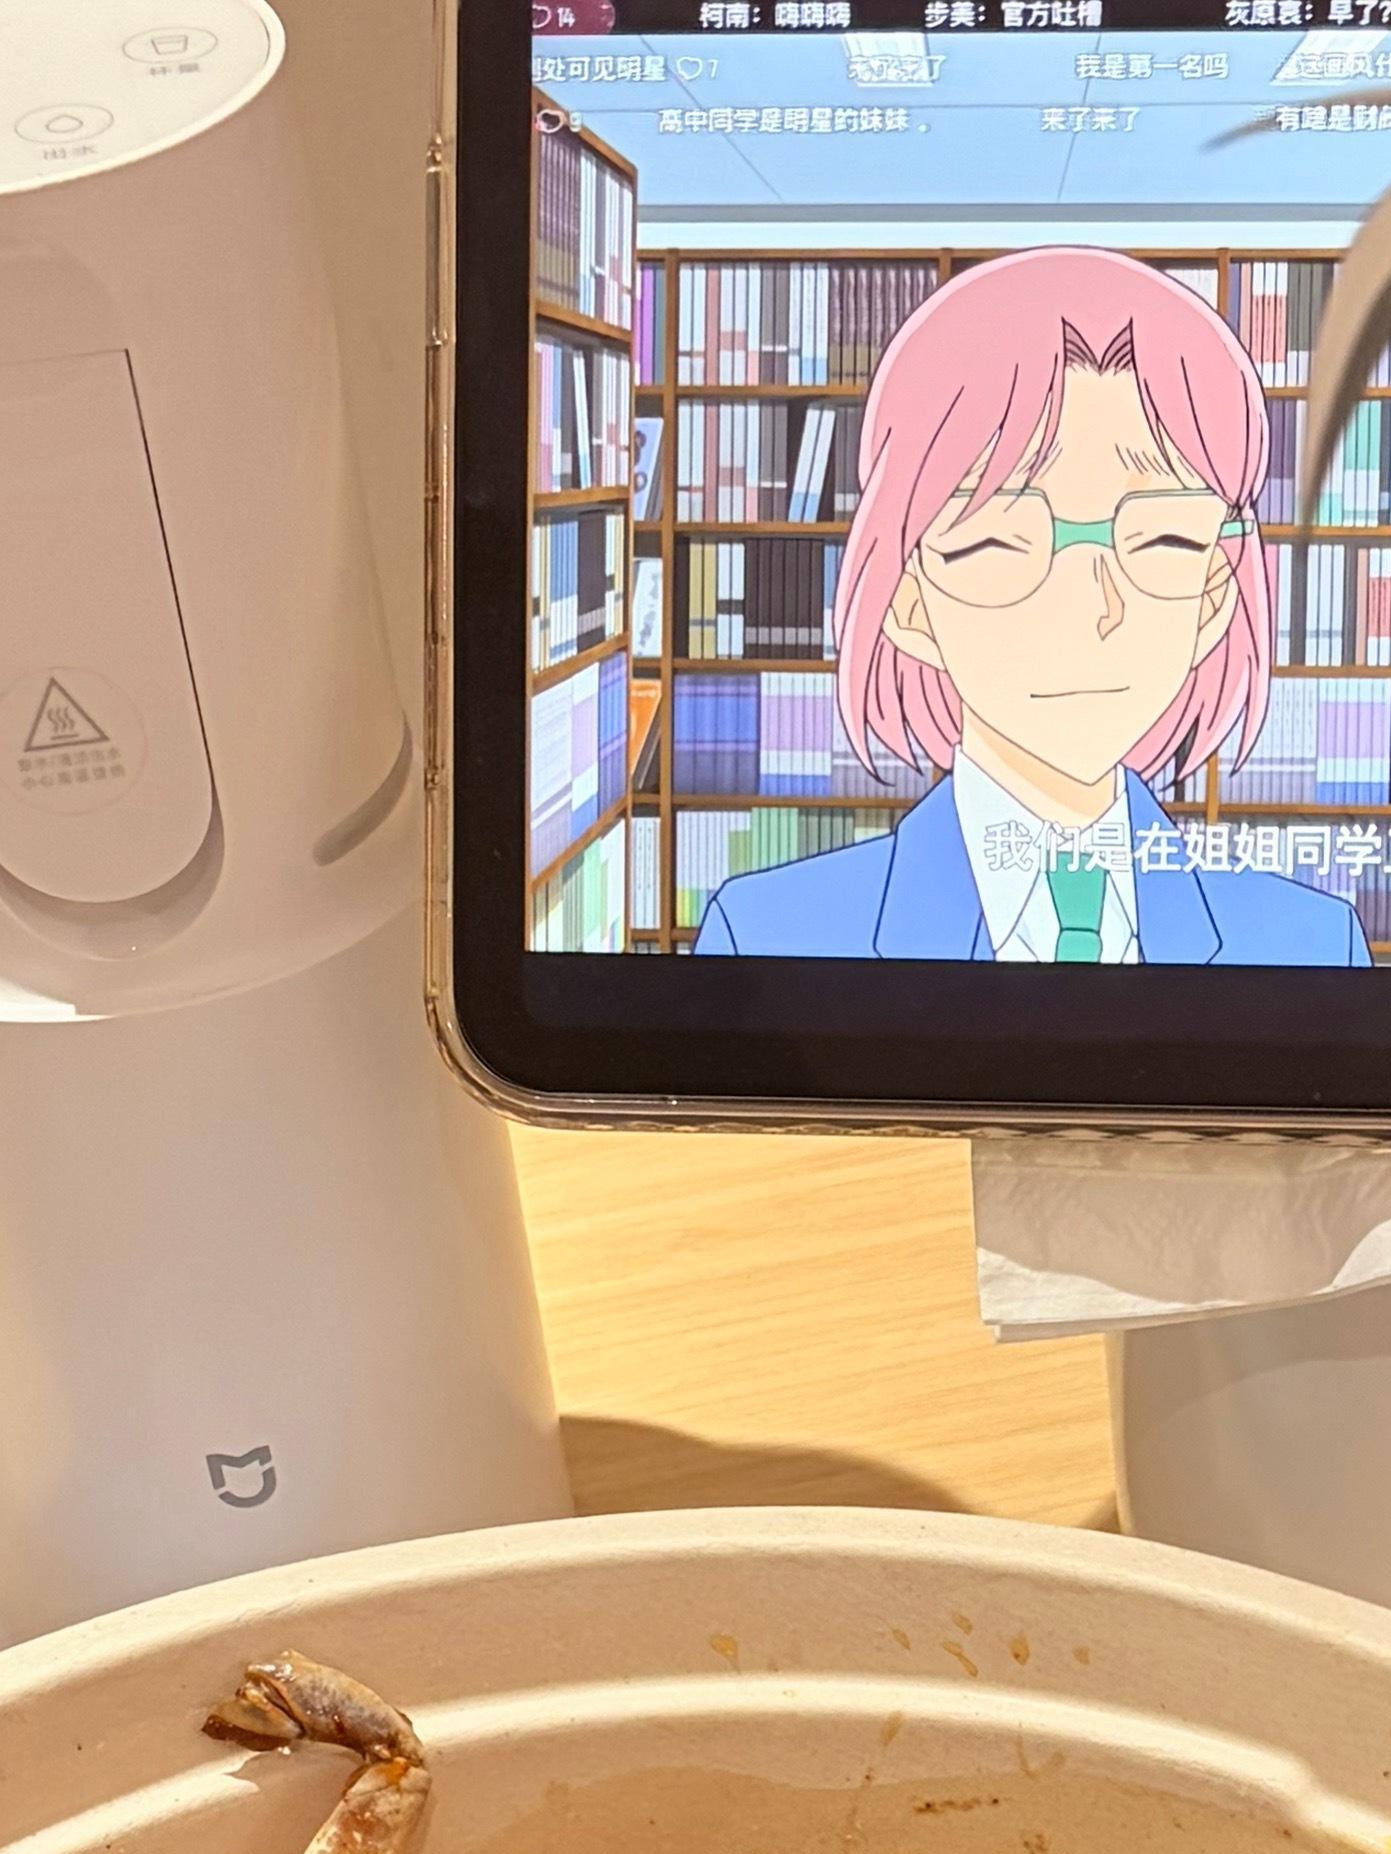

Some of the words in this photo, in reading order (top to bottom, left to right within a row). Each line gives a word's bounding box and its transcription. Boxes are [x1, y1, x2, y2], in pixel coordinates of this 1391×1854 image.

[1074, 53, 1230, 79] 我是第一名吗
[1041, 106, 1141, 132] 来了来了
